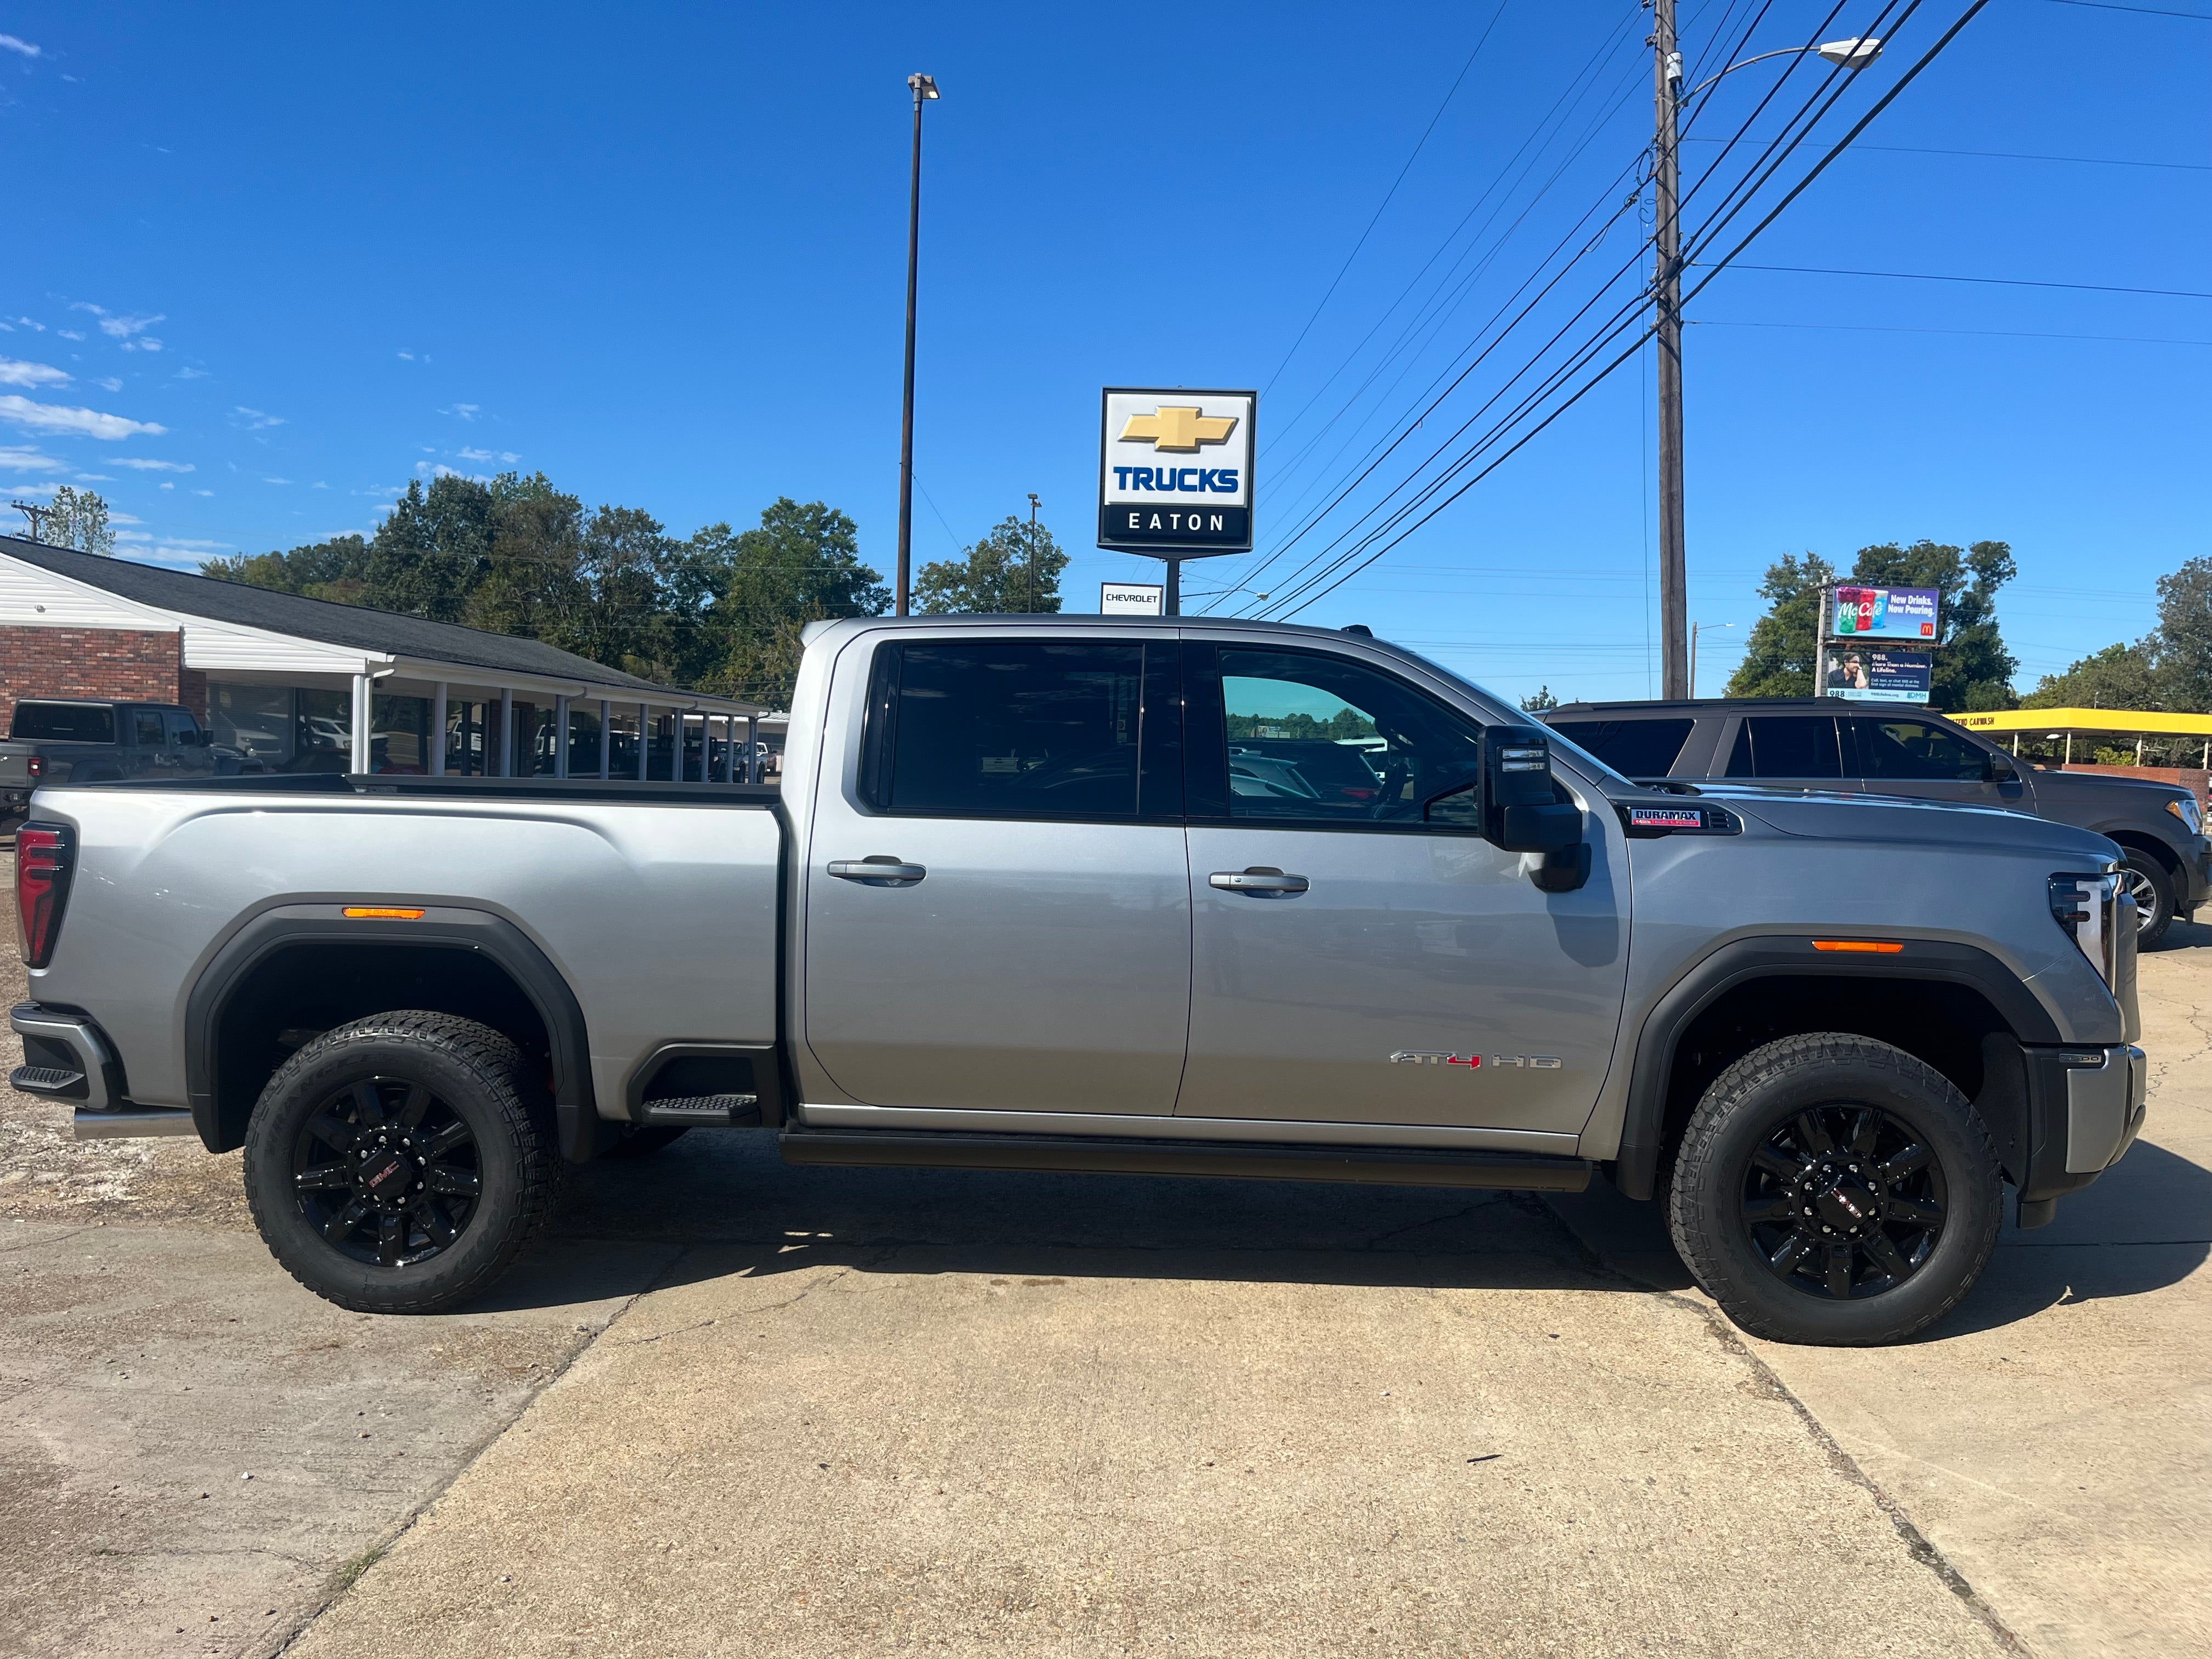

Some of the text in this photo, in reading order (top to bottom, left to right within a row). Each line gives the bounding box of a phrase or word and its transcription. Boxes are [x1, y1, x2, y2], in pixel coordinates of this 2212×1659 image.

[1113, 466, 1238, 493] TRUCKS
[1128, 512, 1223, 531] EATON
[1106, 594, 1158, 602] CHEVROLET
[1891, 594, 1933, 606] New Drinks.
[1888, 603, 1934, 618] Now Pouring.
[1636, 811, 1696, 820] DURAMAX
[1390, 1050, 1562, 1070] AT4 HD
[369, 1160, 399, 1188] GMC
